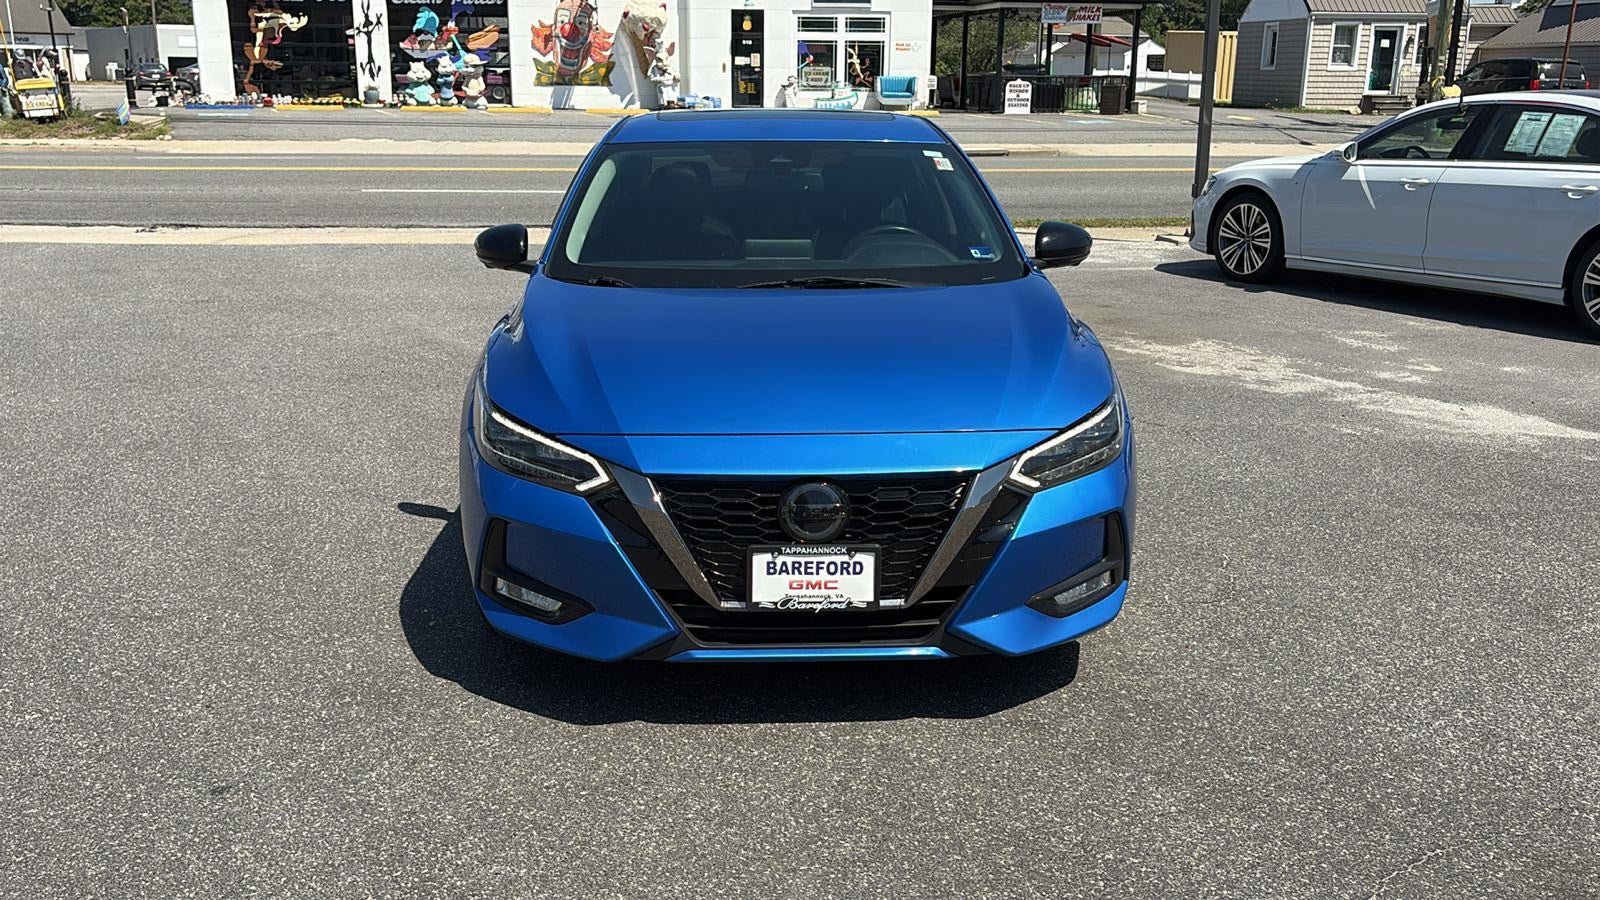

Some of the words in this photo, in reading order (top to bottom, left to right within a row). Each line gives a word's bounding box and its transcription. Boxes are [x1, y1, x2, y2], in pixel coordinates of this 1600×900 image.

[766, 561, 864, 576] BAREFORD
[789, 580, 838, 590] GMC
[777, 597, 851, 613] Bareford
